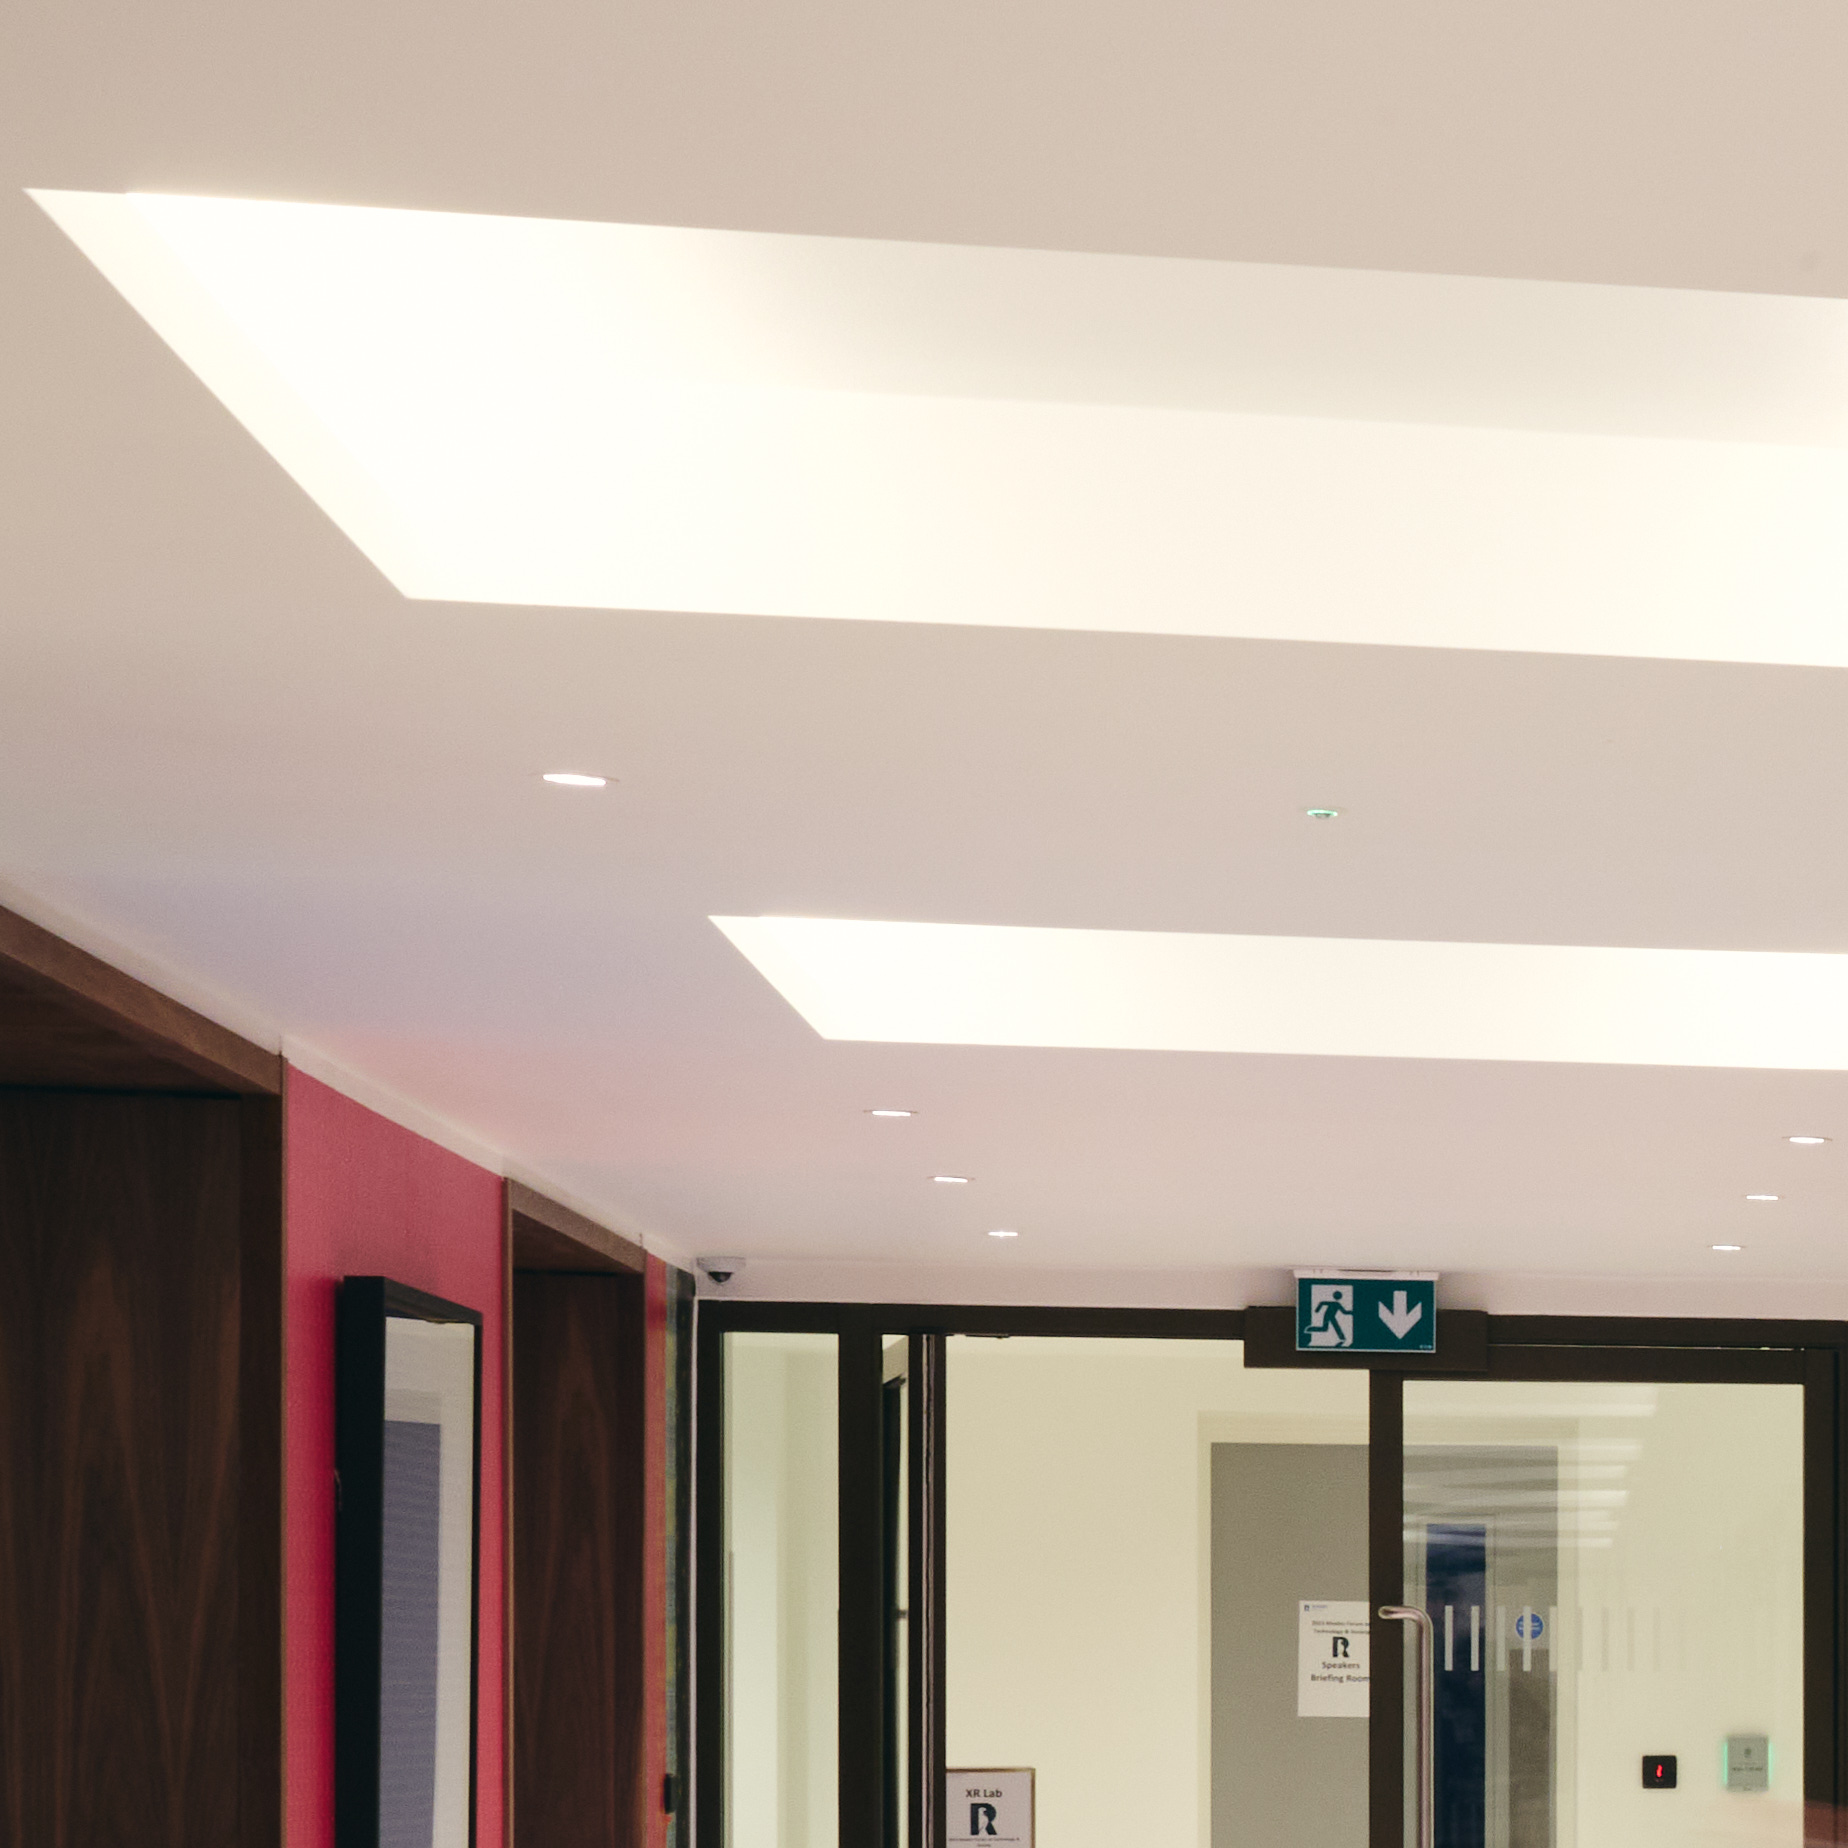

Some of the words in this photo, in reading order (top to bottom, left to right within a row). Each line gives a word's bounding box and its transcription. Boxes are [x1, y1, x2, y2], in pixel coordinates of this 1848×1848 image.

[1322, 1661, 1360, 1670] Speakers
[1311, 1674, 1343, 1683] Briefing
[965, 1789, 980, 1798] XR
[983, 1789, 1002, 1798] Lab
